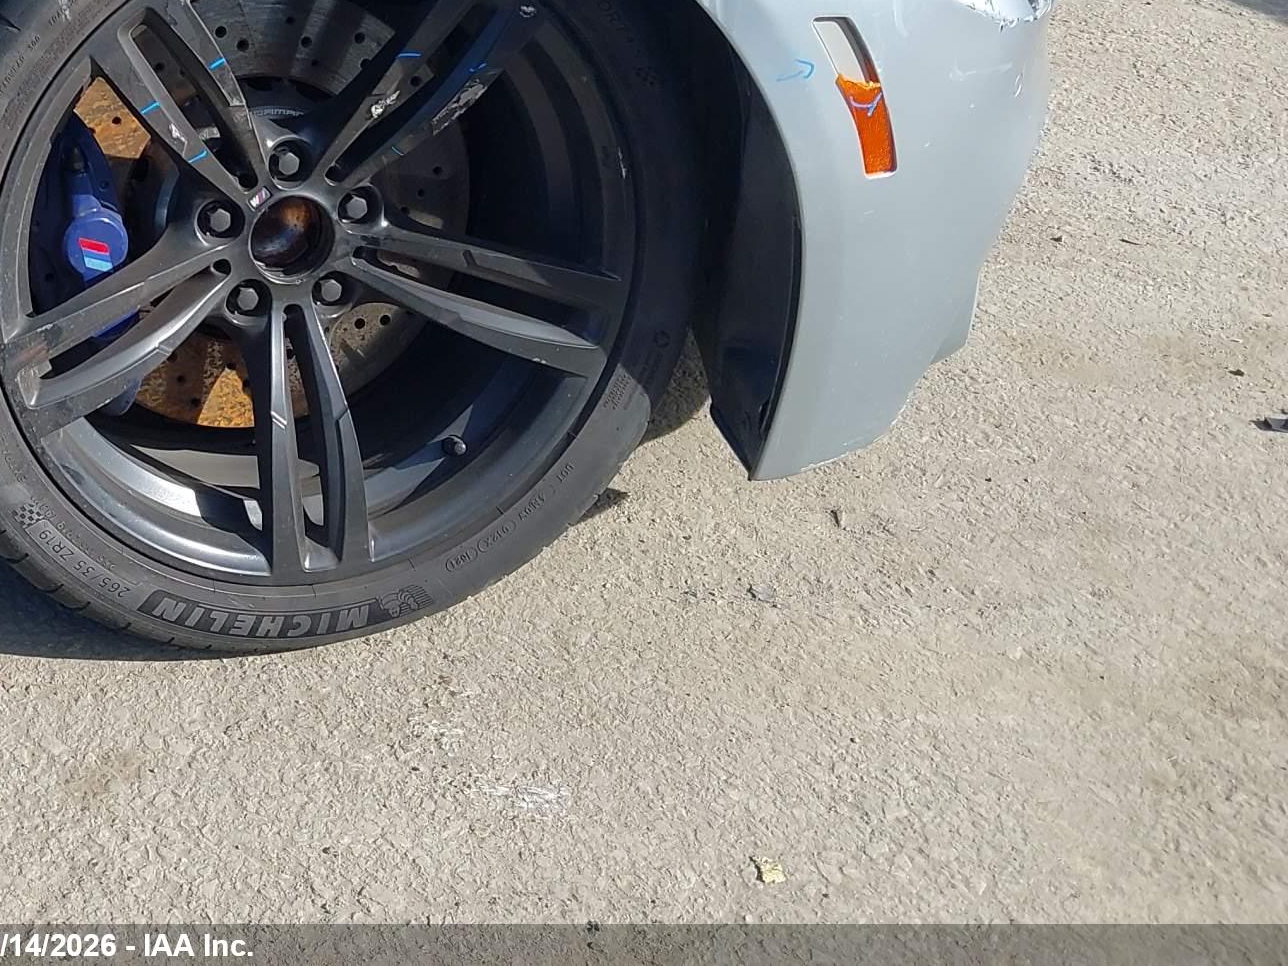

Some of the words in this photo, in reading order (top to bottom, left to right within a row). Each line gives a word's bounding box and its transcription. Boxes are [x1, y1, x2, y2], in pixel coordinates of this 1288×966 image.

[38, 529, 76, 562] ZR19
[73, 561, 132, 598] 265/35
[154, 598, 372, 638] MICHELIN
